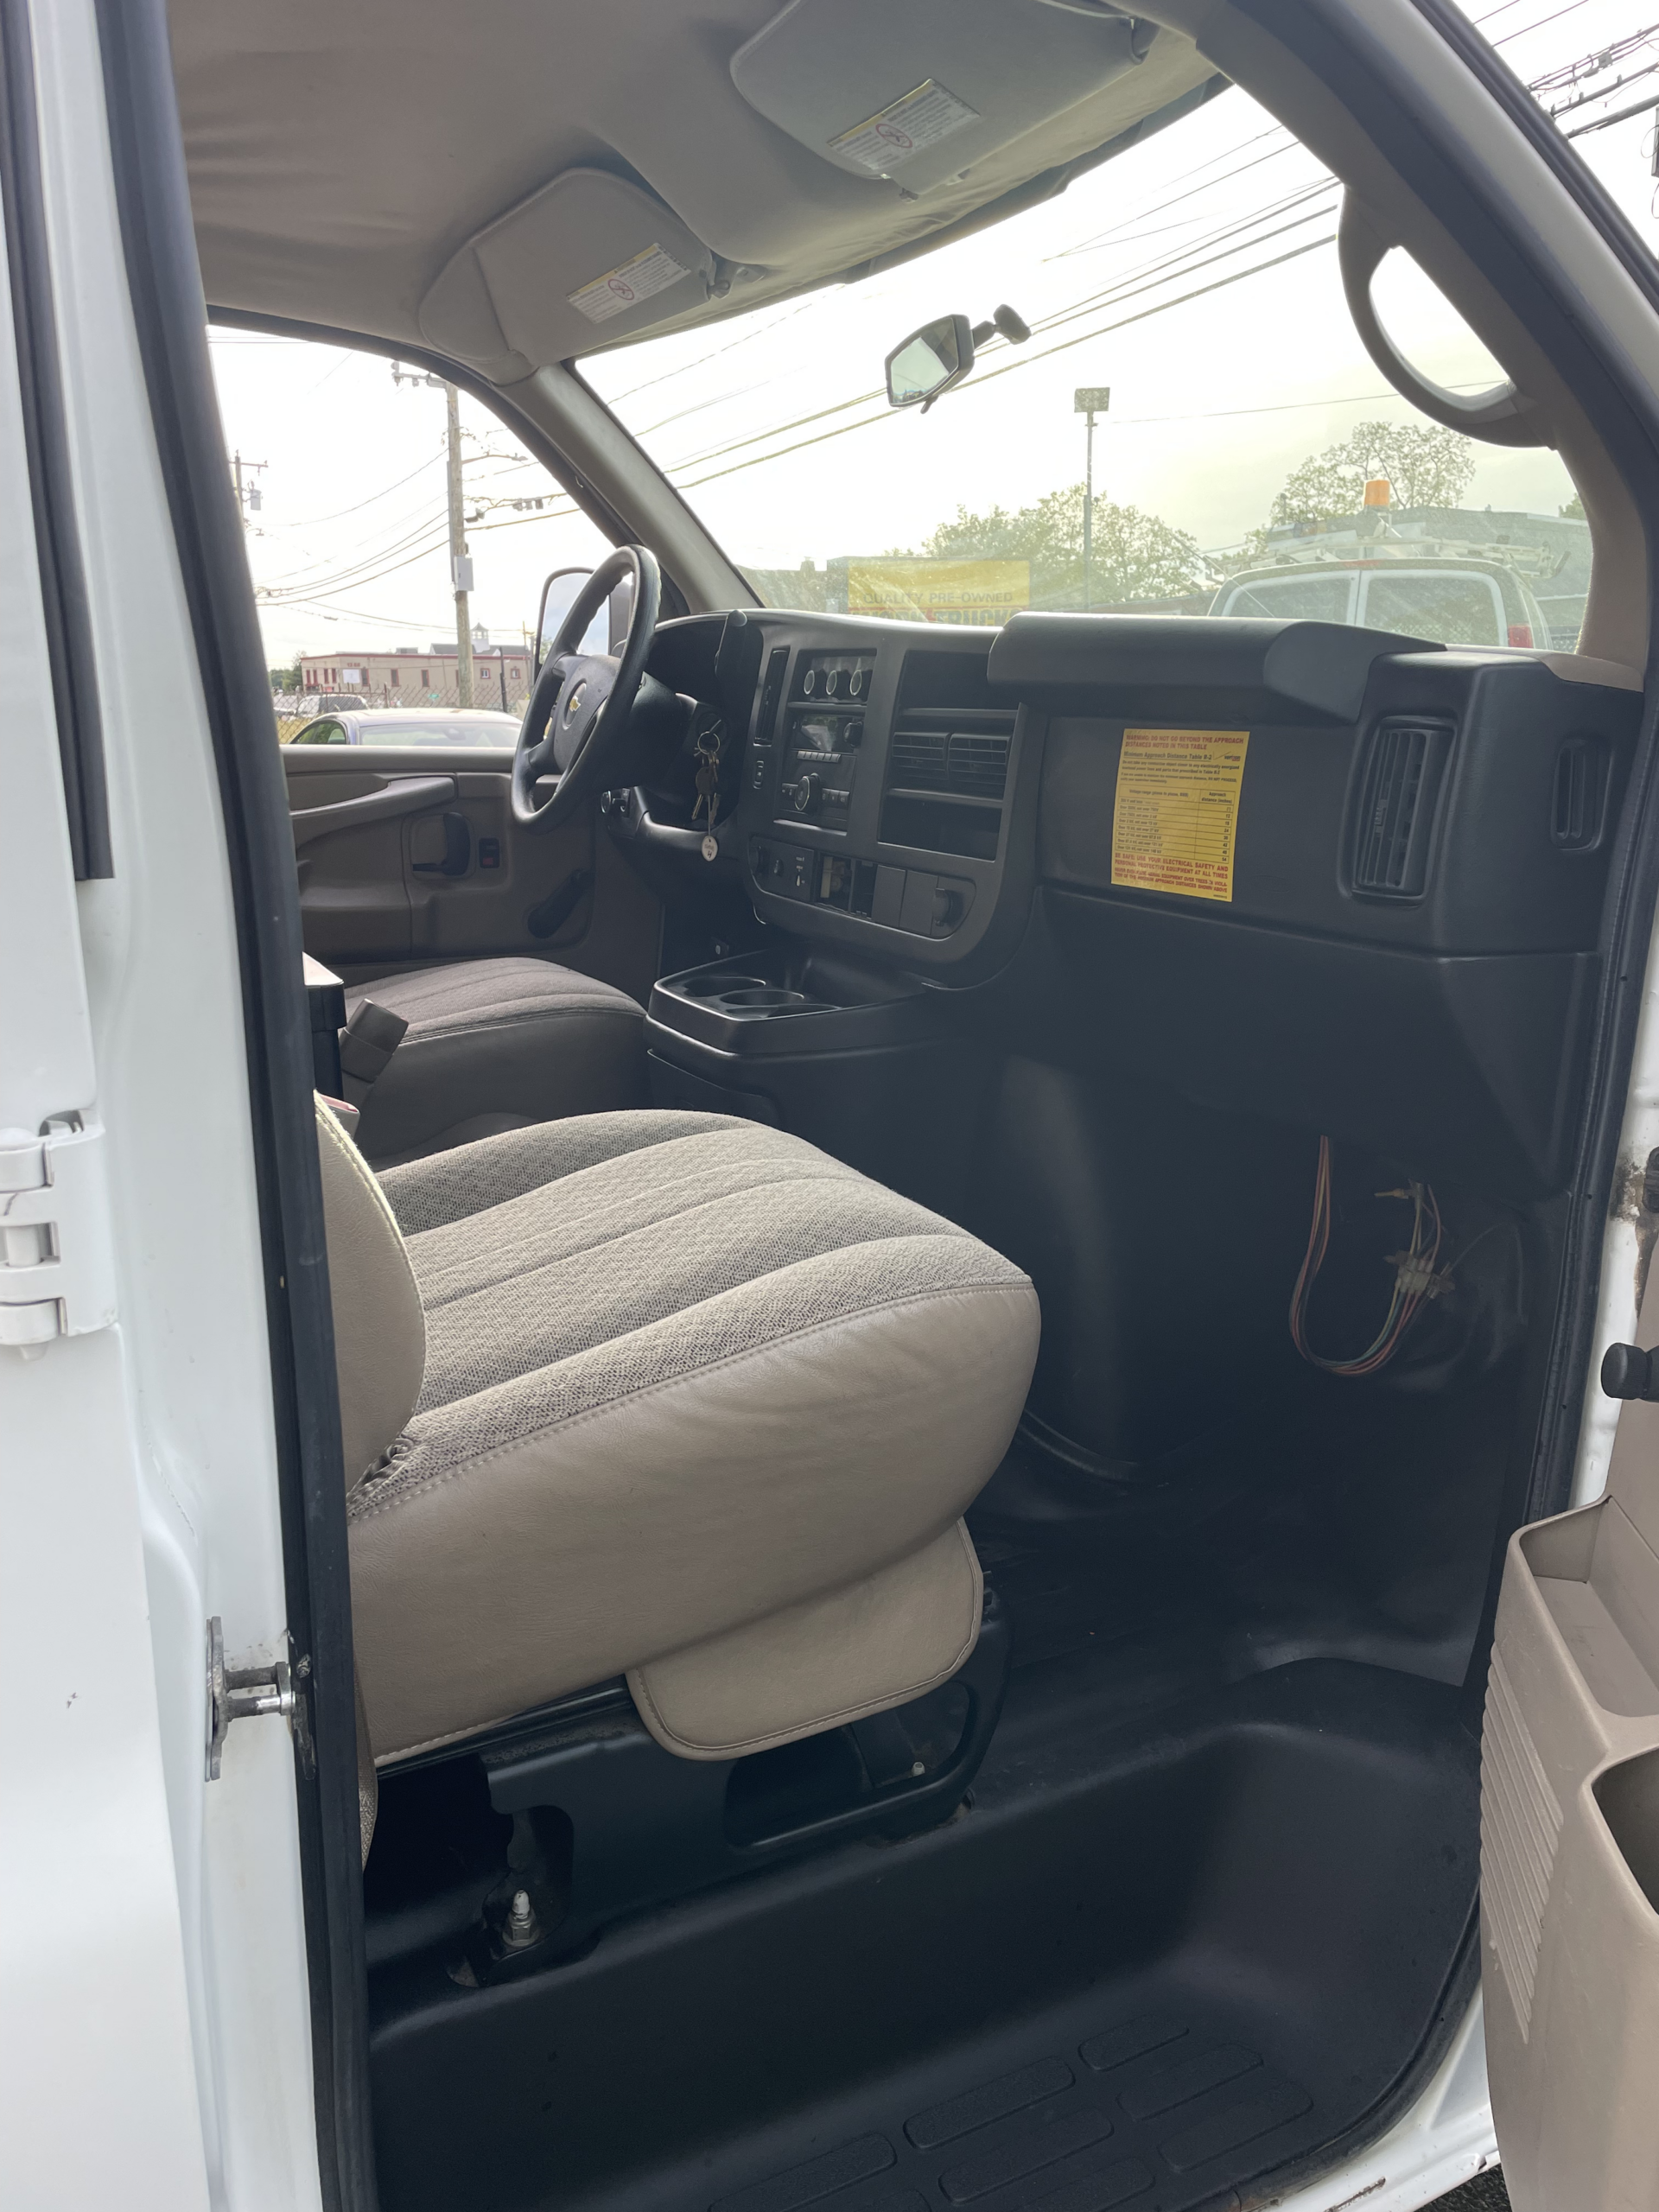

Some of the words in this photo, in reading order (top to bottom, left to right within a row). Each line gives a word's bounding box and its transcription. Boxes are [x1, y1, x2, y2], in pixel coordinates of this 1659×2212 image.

[864, 592, 924, 605] QUALITY
[929, 591, 1013, 603] PRE-OWNED
[1137, 861, 1165, 870] PROTECTIVE
[1162, 858, 1193, 867] ELECTRICAL
